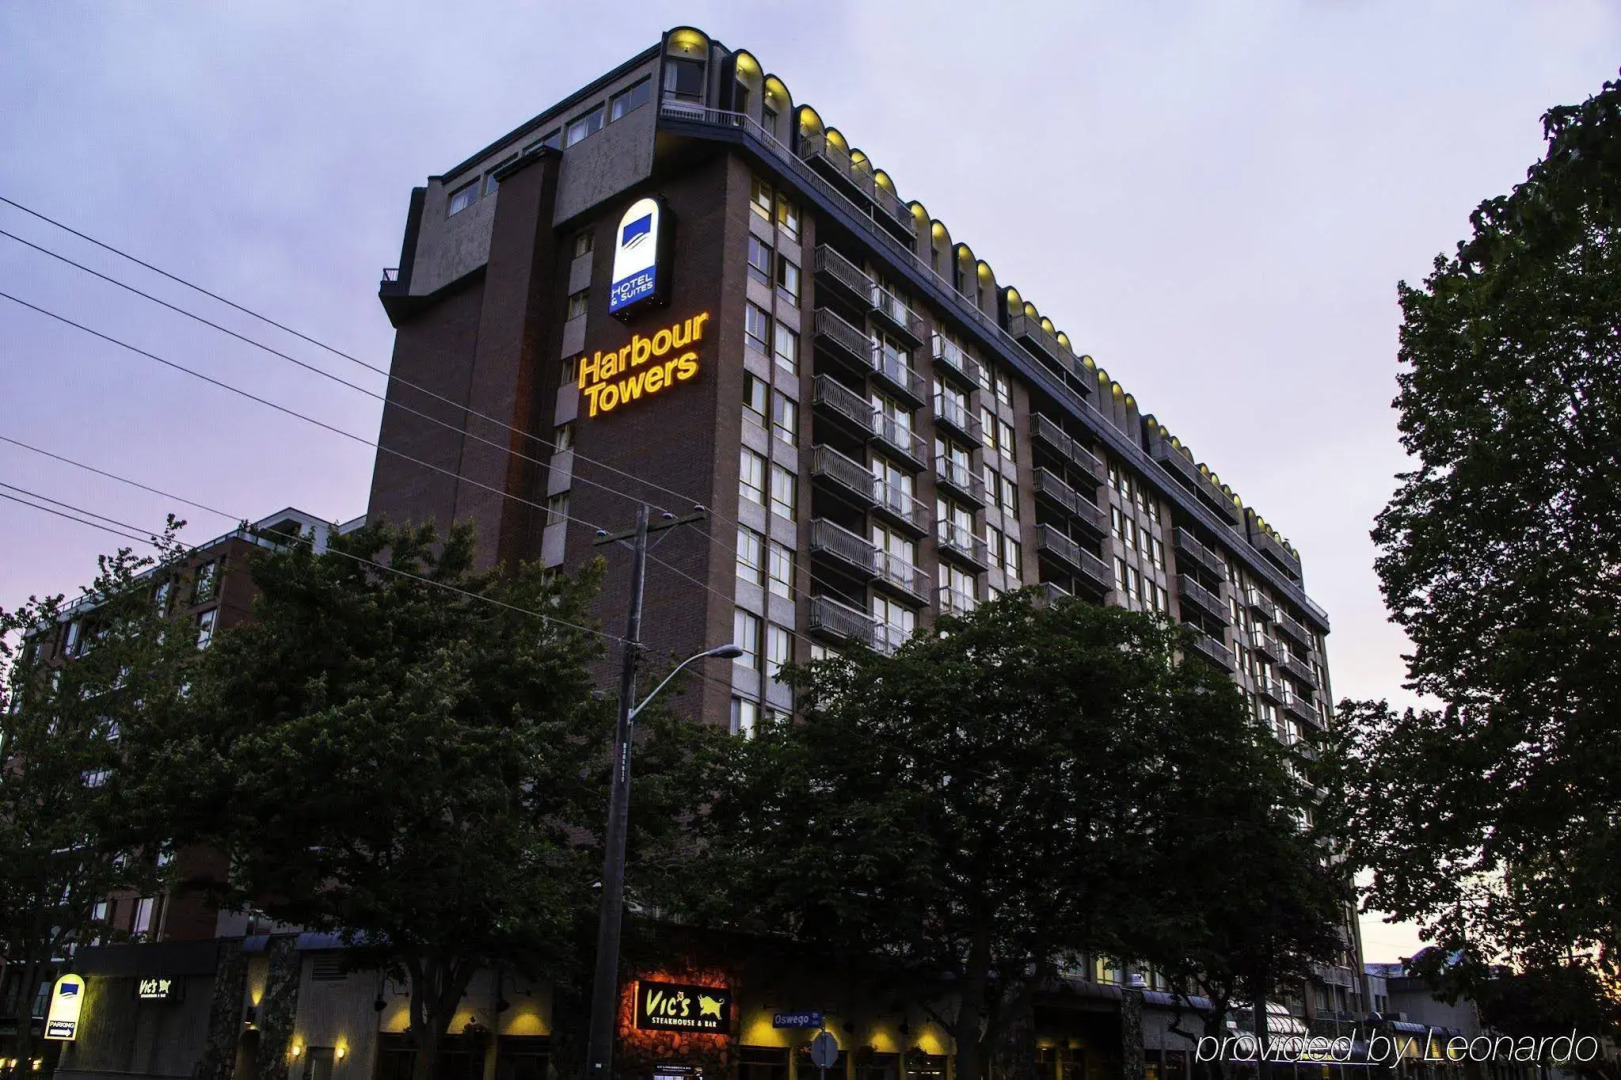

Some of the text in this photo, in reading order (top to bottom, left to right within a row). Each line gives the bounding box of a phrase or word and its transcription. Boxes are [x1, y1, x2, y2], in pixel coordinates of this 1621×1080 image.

[611, 281, 653, 306] & SUITES
[612, 273, 653, 298] HOTEL
[578, 312, 709, 389] Harbour
[584, 352, 699, 417] Towers
[50, 1021, 75, 1029] PARKING
[651, 1017, 695, 1026] STEAKHOUSE
[775, 1014, 809, 1026] Oswego
